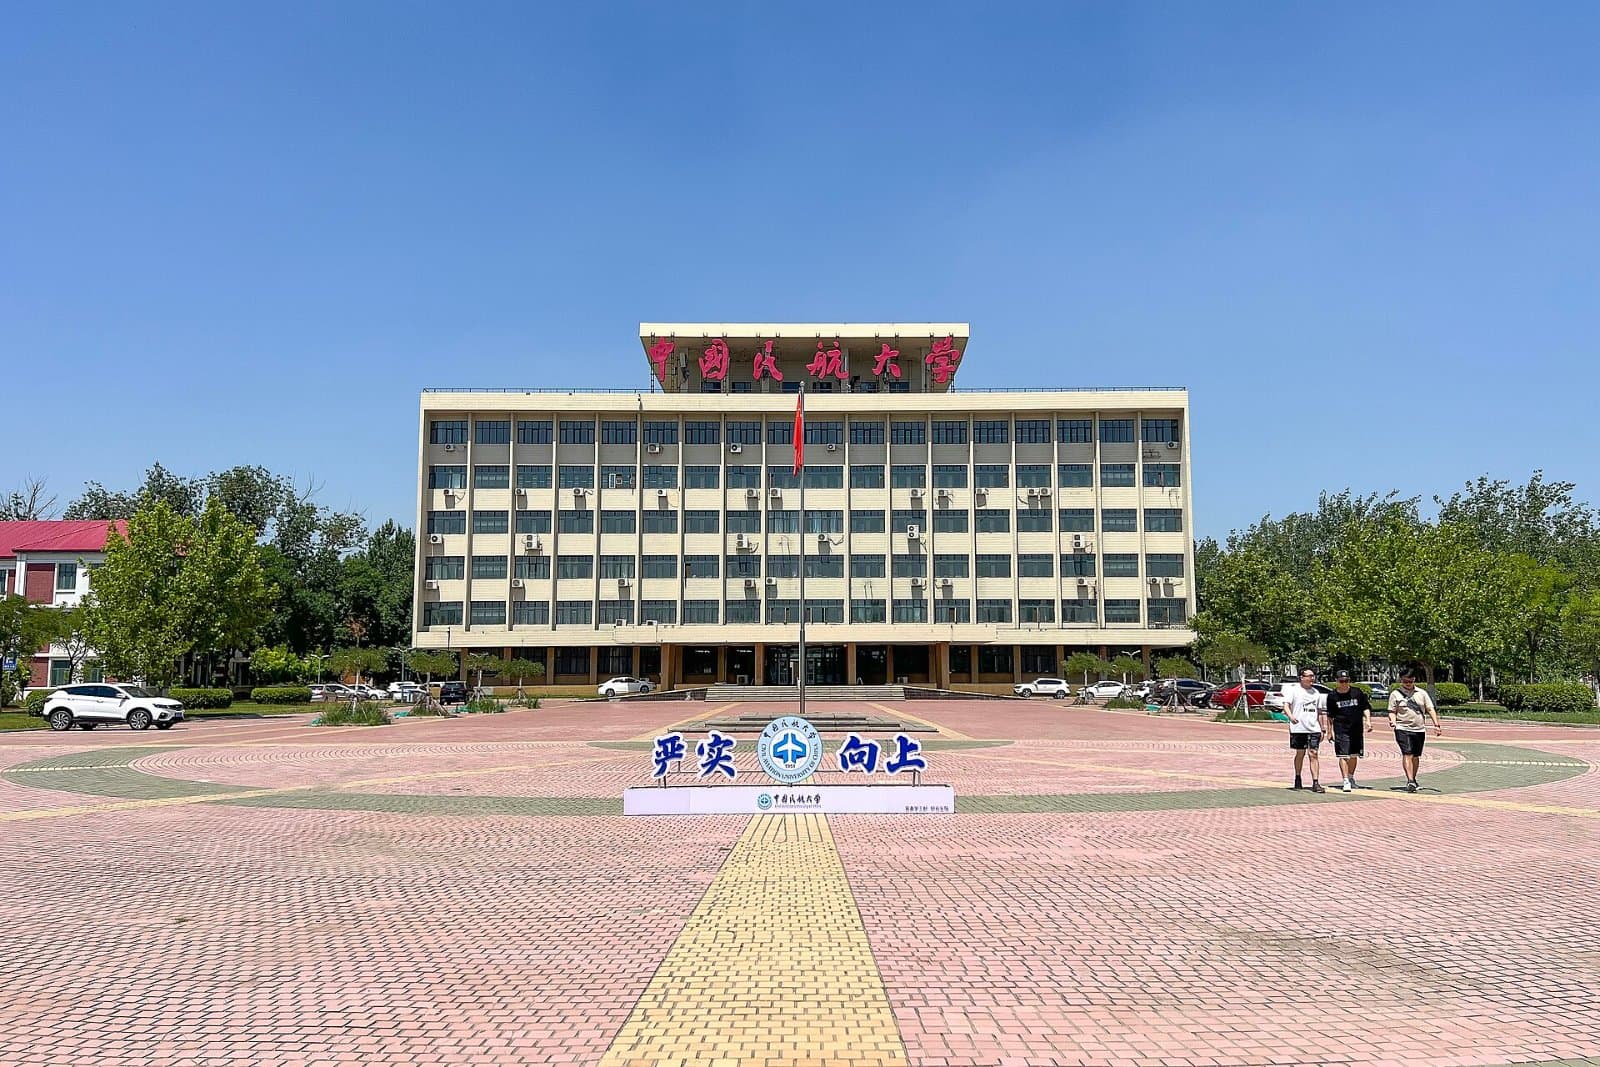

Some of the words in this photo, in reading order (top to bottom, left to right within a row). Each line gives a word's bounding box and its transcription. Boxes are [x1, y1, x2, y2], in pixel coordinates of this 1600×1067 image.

[649, 336, 960, 384] 中国民航大学
[763, 719, 817, 740] 中国民航大学
[654, 733, 737, 778] 严实
[839, 735, 927, 775] 向上
[773, 793, 821, 805] 中国民航大学
